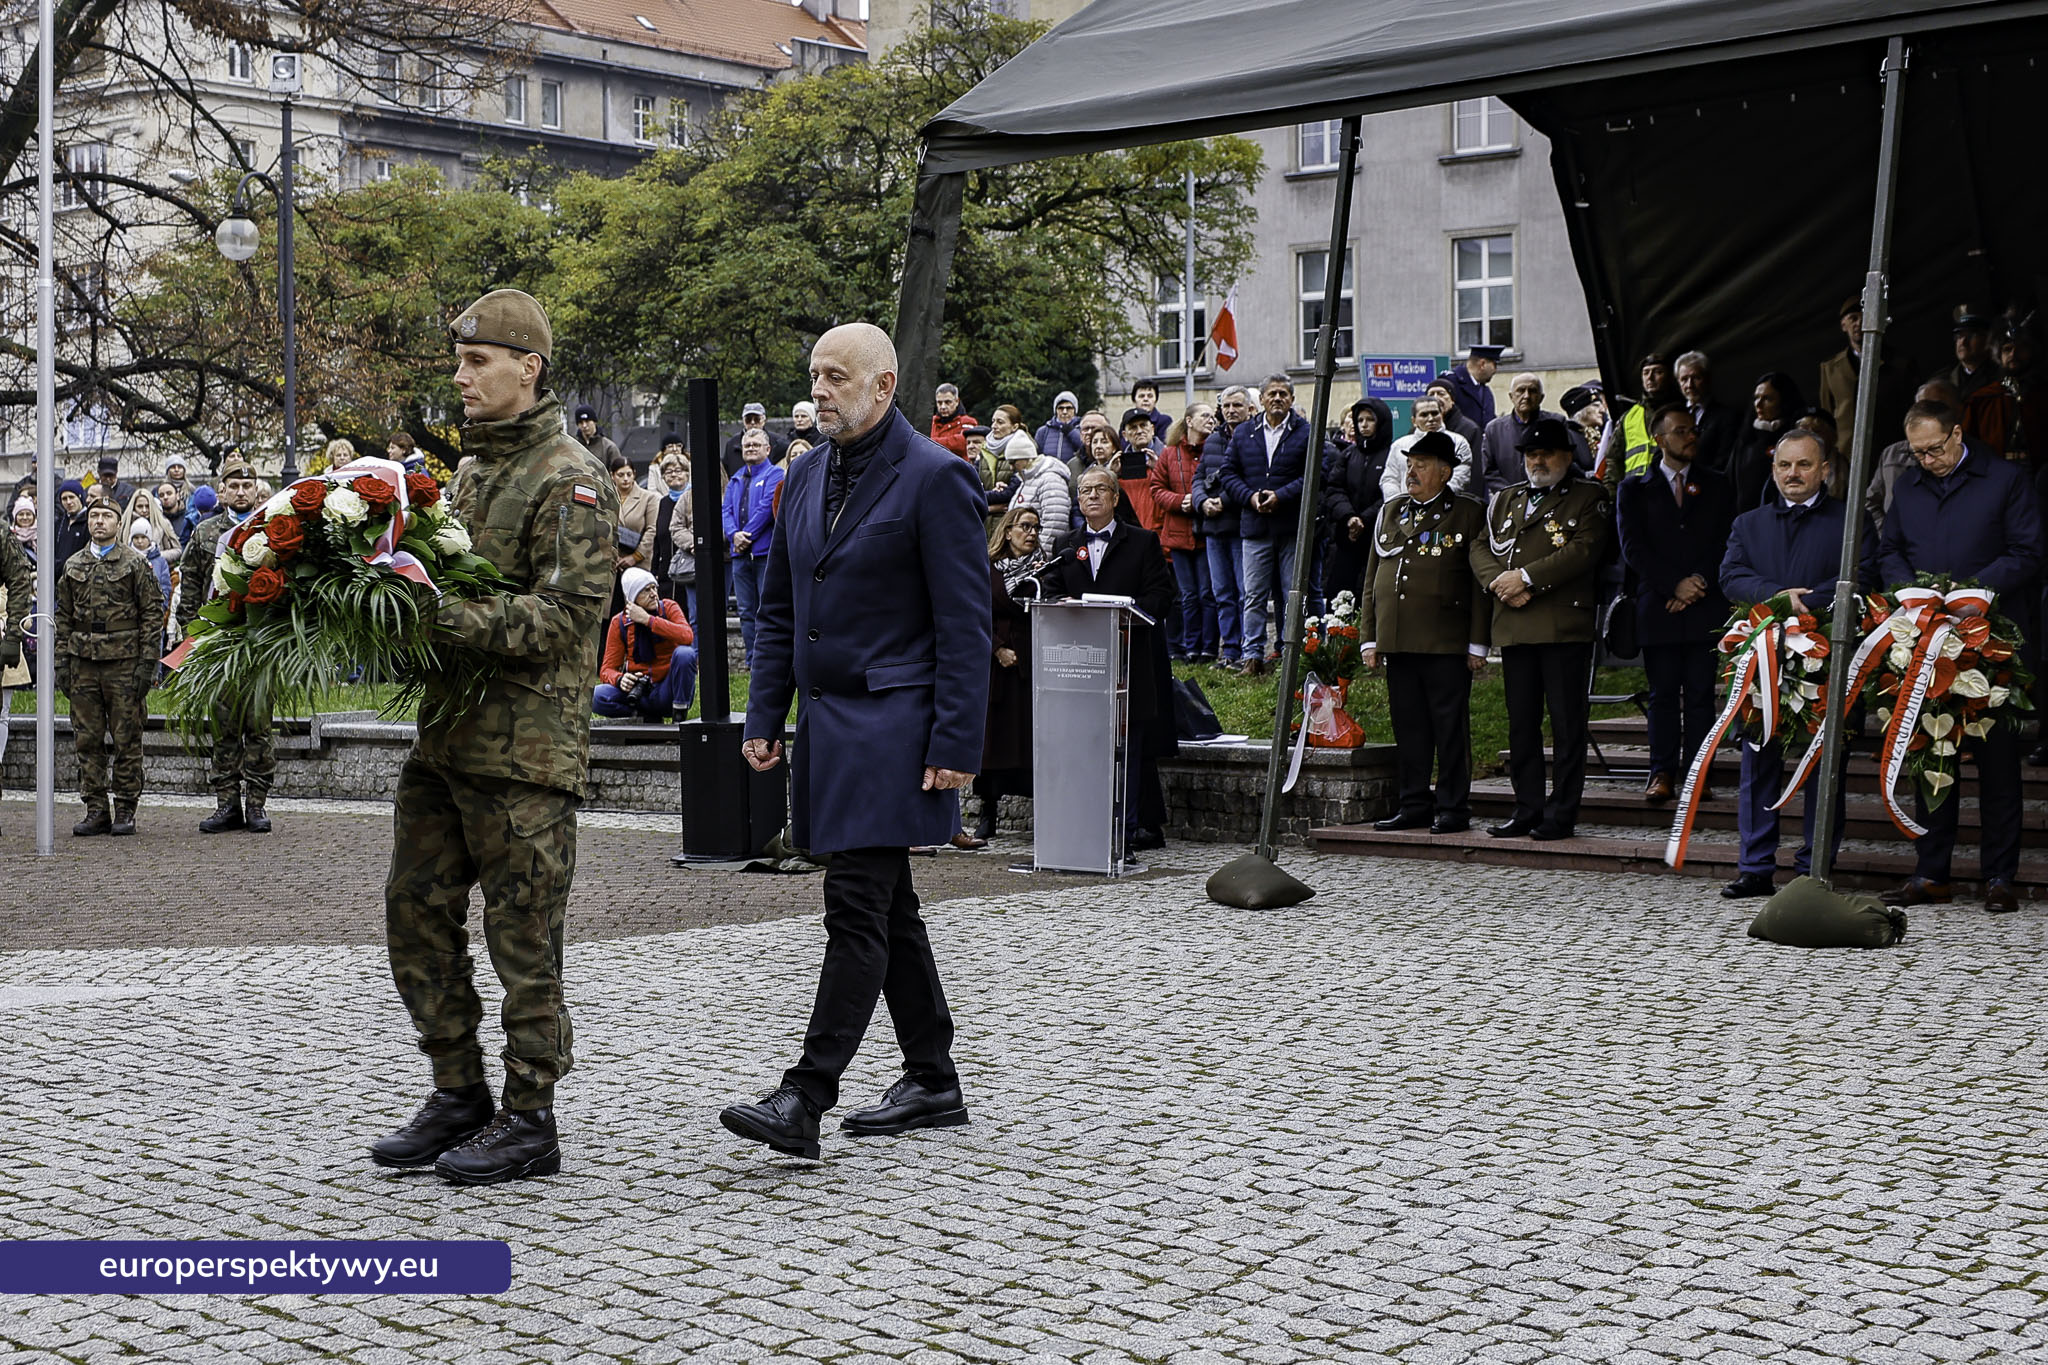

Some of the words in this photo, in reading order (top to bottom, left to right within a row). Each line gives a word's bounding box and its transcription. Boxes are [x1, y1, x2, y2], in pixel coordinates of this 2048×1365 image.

[1377, 365, 1390, 375] A4
[1393, 361, 1427, 375] Kraków
[1395, 380, 1429, 393] Wrocła
